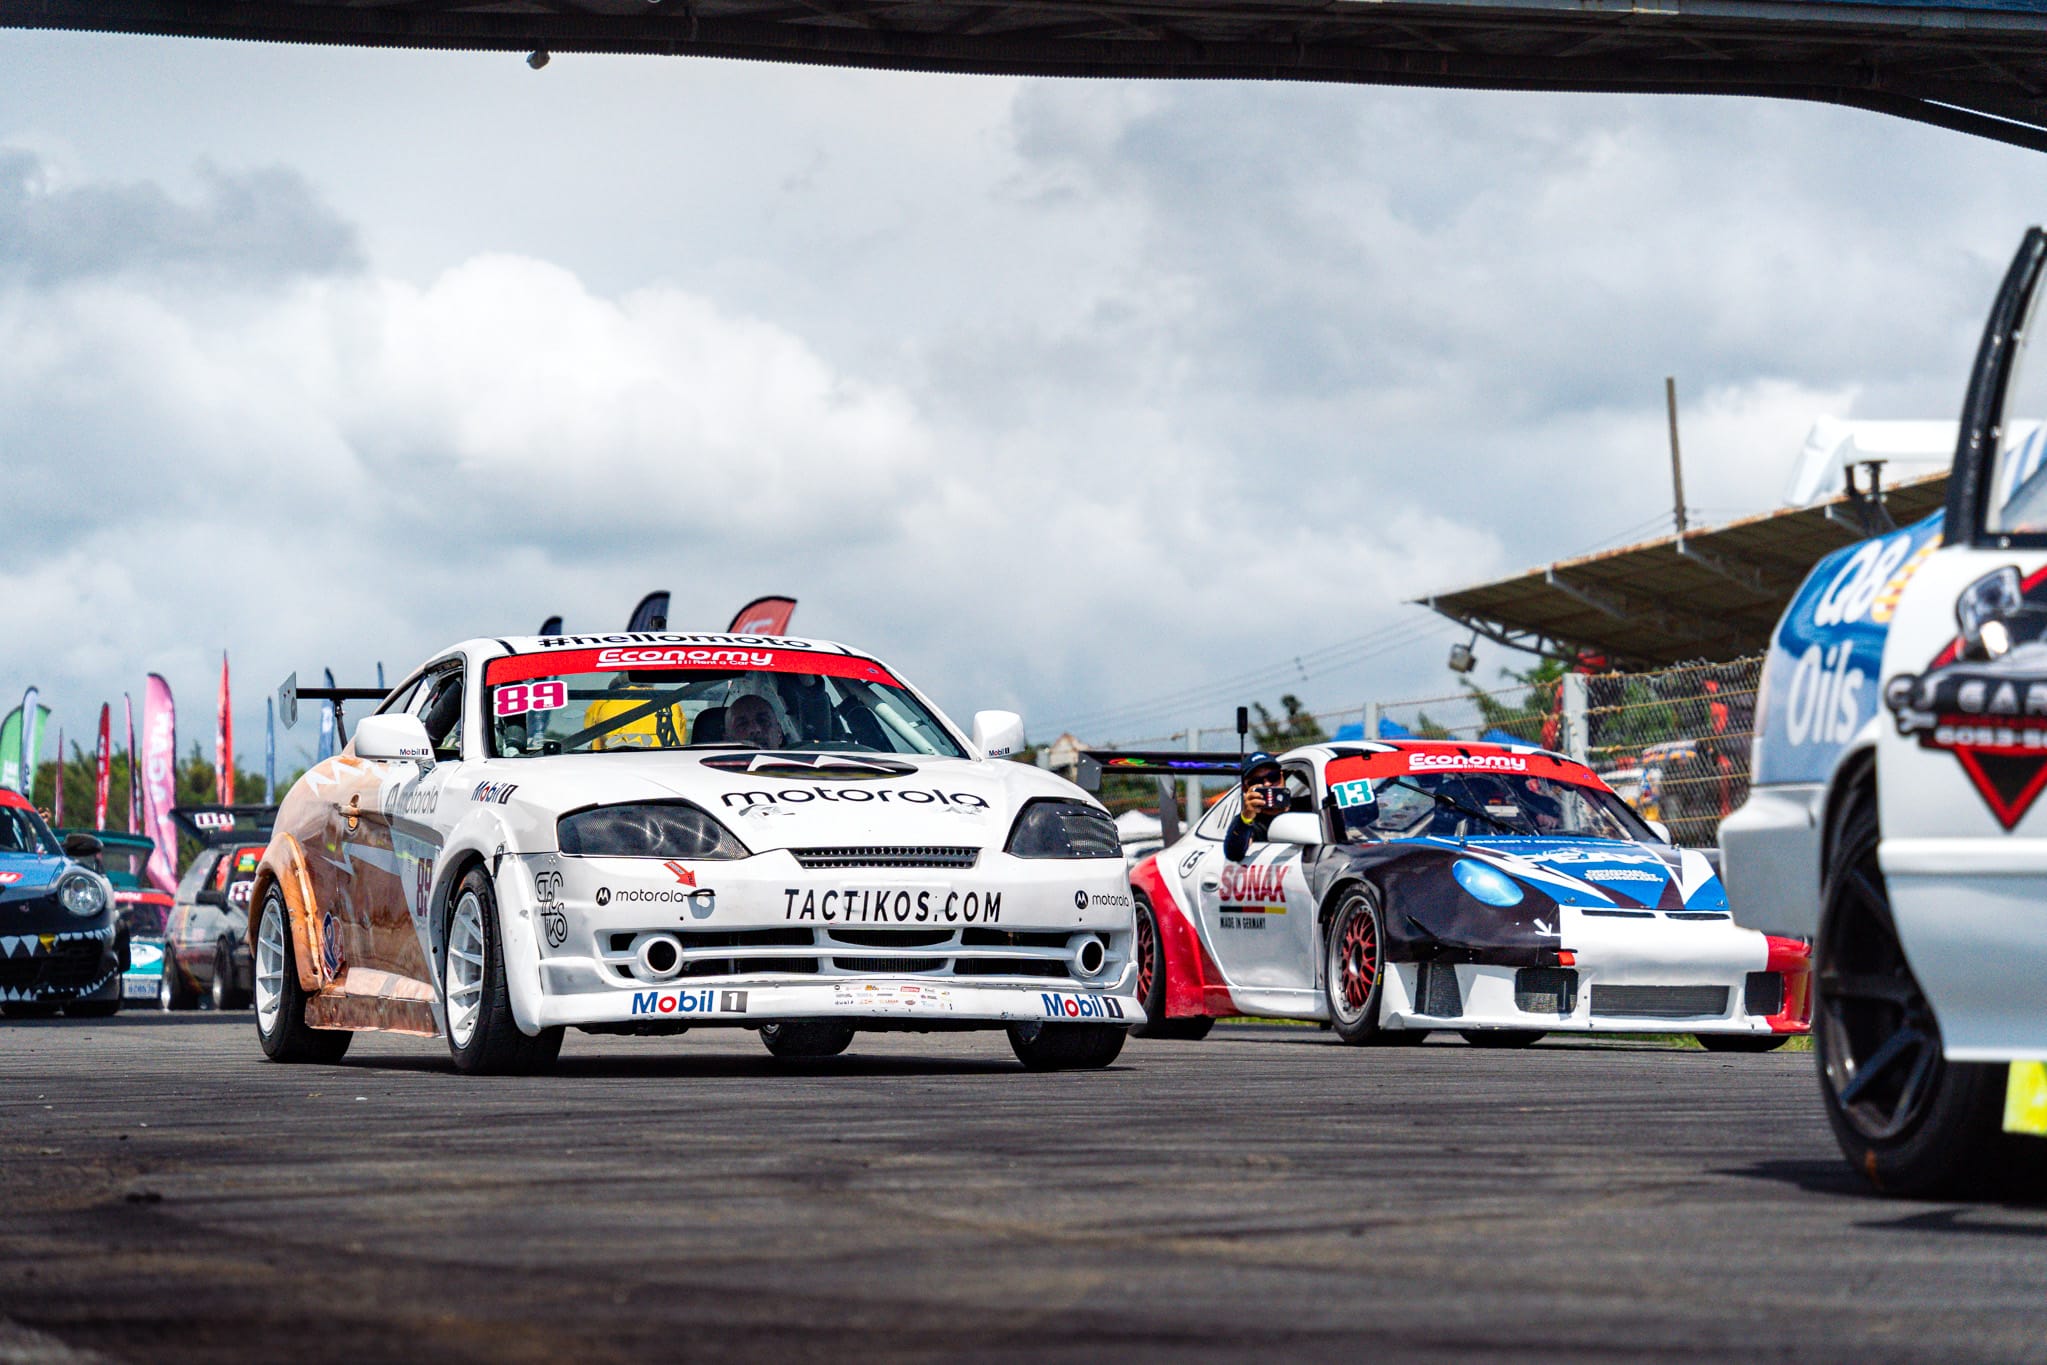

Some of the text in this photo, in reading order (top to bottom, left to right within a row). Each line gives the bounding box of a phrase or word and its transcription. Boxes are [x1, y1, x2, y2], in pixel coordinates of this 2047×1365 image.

[1814, 535, 1911, 627] Q8
[538, 633, 812, 649] #hellomoto
[597, 650, 774, 666] Economy
[497, 682, 565, 715] 89
[1787, 639, 1864, 747] Oils
[400, 748, 420, 756] Mobil
[989, 748, 1004, 756] Mobil
[1409, 753, 1526, 770] Economy
[471, 781, 504, 803] Mobil
[720, 786, 990, 809] motorola
[1332, 780, 1372, 806] 13
[1219, 864, 1289, 903] SONAX
[616, 888, 684, 903] motorola
[784, 889, 1001, 923] TACTIKOS.COM
[1092, 893, 1130, 907] motorola
[1220, 917, 1235, 929] MADE
[1243, 917, 1266, 929] GERMANY
[632, 990, 714, 1015] Mobil
[1041, 993, 1104, 1018] Mobil
